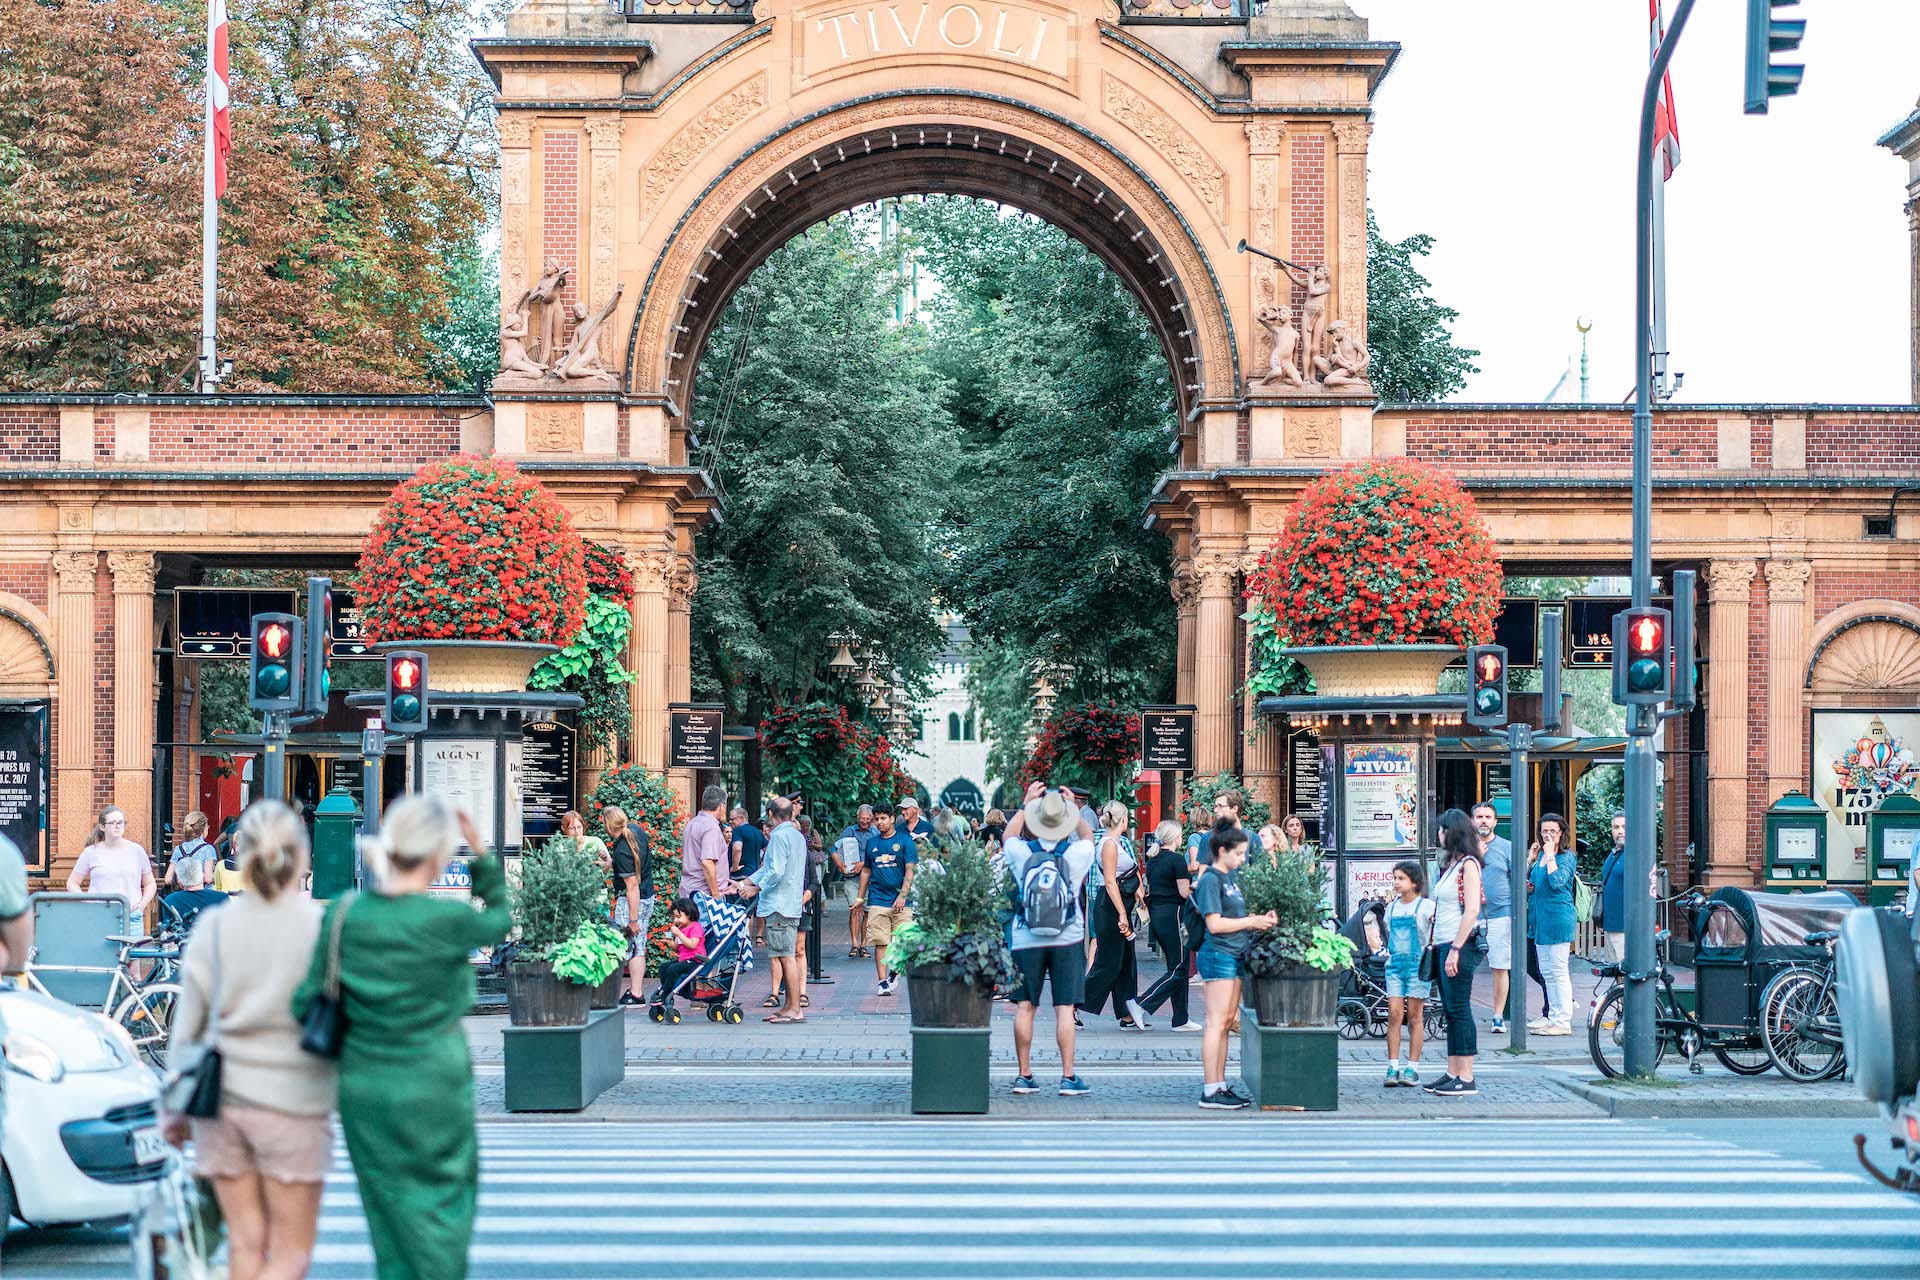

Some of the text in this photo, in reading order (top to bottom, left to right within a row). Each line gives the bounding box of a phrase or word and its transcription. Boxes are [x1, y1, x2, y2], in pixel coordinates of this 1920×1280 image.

[817, 3, 1048, 61] TIVOLI
[532, 723, 557, 731] TIVOLI
[434, 751, 482, 760] AUGUST
[1354, 760, 1412, 773] TIVOLI
[13, 774, 28, 784] 20/7
[1835, 788, 1872, 808] 175
